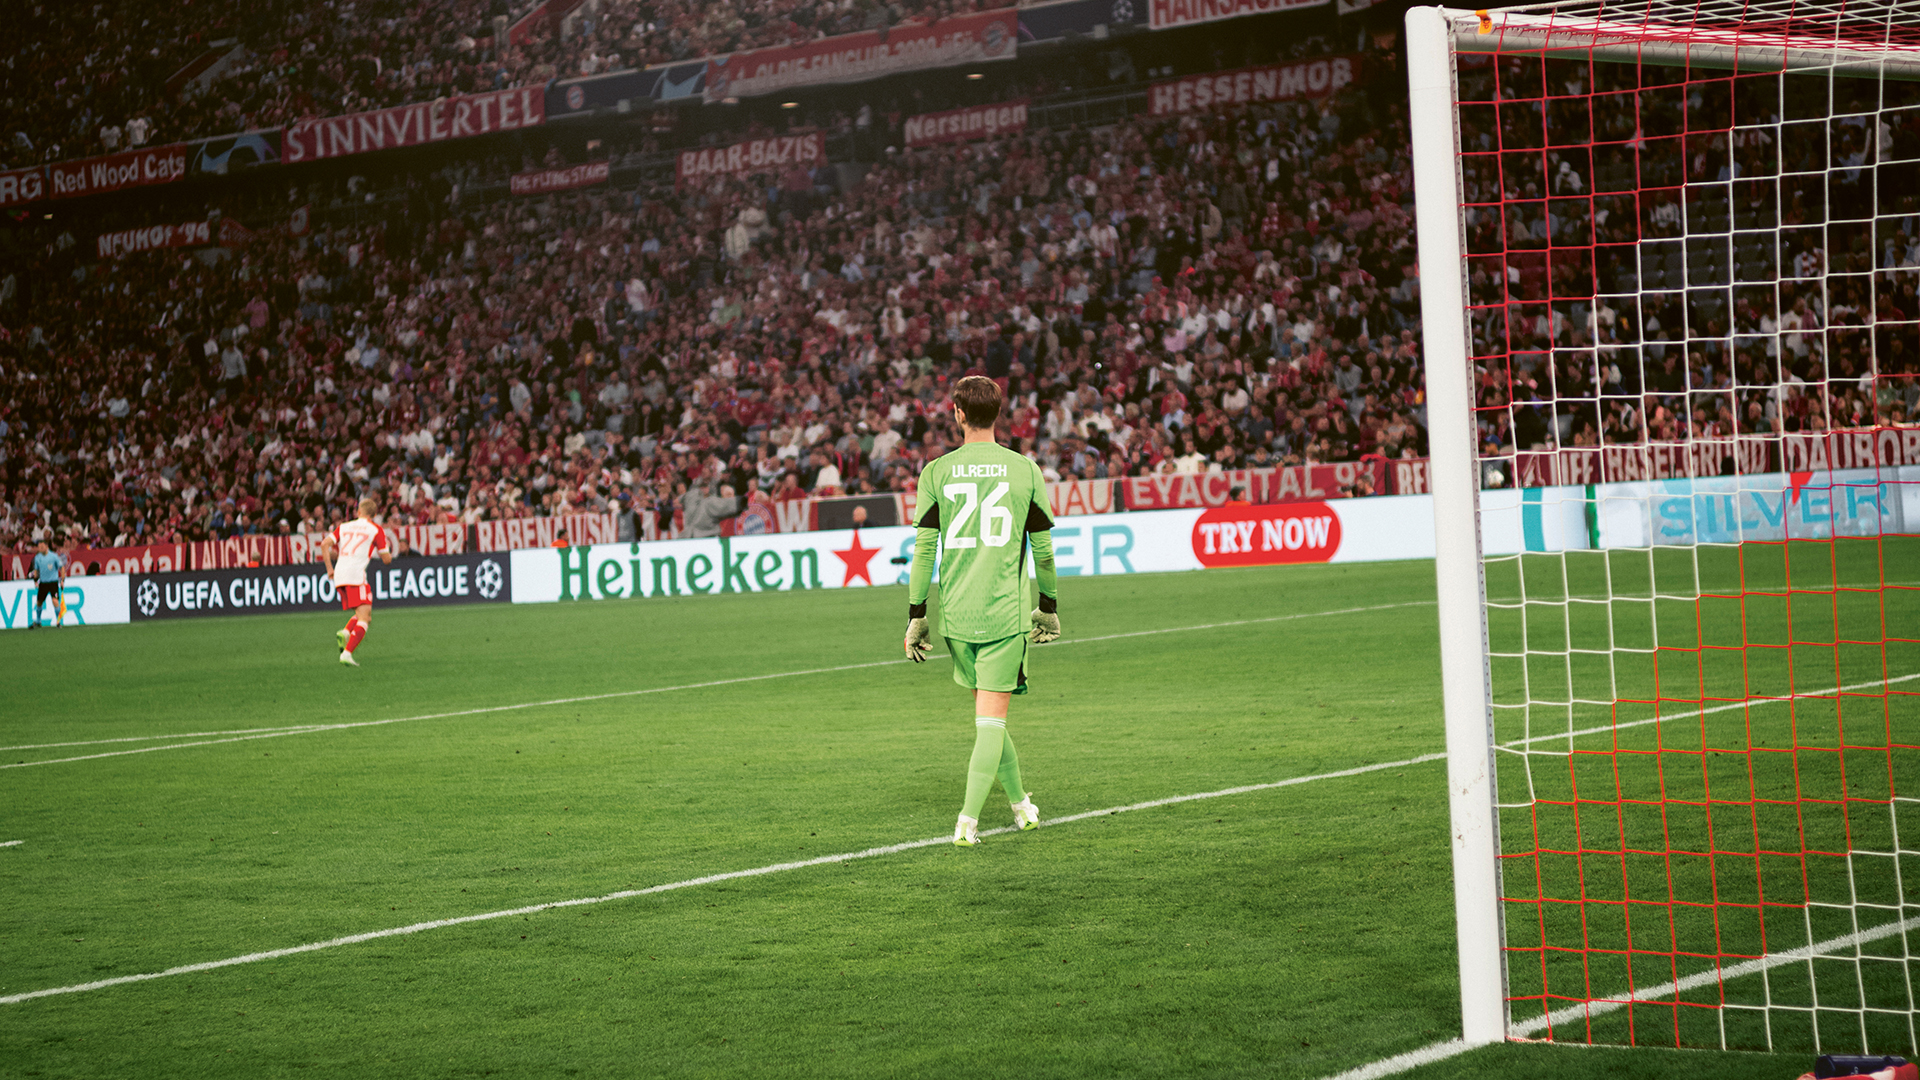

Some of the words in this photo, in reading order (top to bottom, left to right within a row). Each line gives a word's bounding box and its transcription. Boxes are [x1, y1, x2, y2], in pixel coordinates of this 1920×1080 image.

[1154, 58, 1353, 115] HESSENMOB
[905, 103, 1028, 143] Nersingen
[54, 166, 86, 194] Red
[91, 156, 139, 188] Wood
[144, 152, 185, 180] Cats
[682, 134, 818, 176] BAAR-BAZIS
[952, 464, 1008, 478] ULREICH
[943, 482, 1013, 549] 26
[1660, 479, 1890, 537] SILVER
[340, 531, 369, 557] 27
[1199, 521, 1256, 555] TRY
[1262, 516, 1332, 550] NOW
[165, 580, 224, 611] UEFA
[229, 574, 340, 607] CHAMPIO
[375, 564, 469, 600] LEAGUE
[557, 537, 823, 601] Heineken
